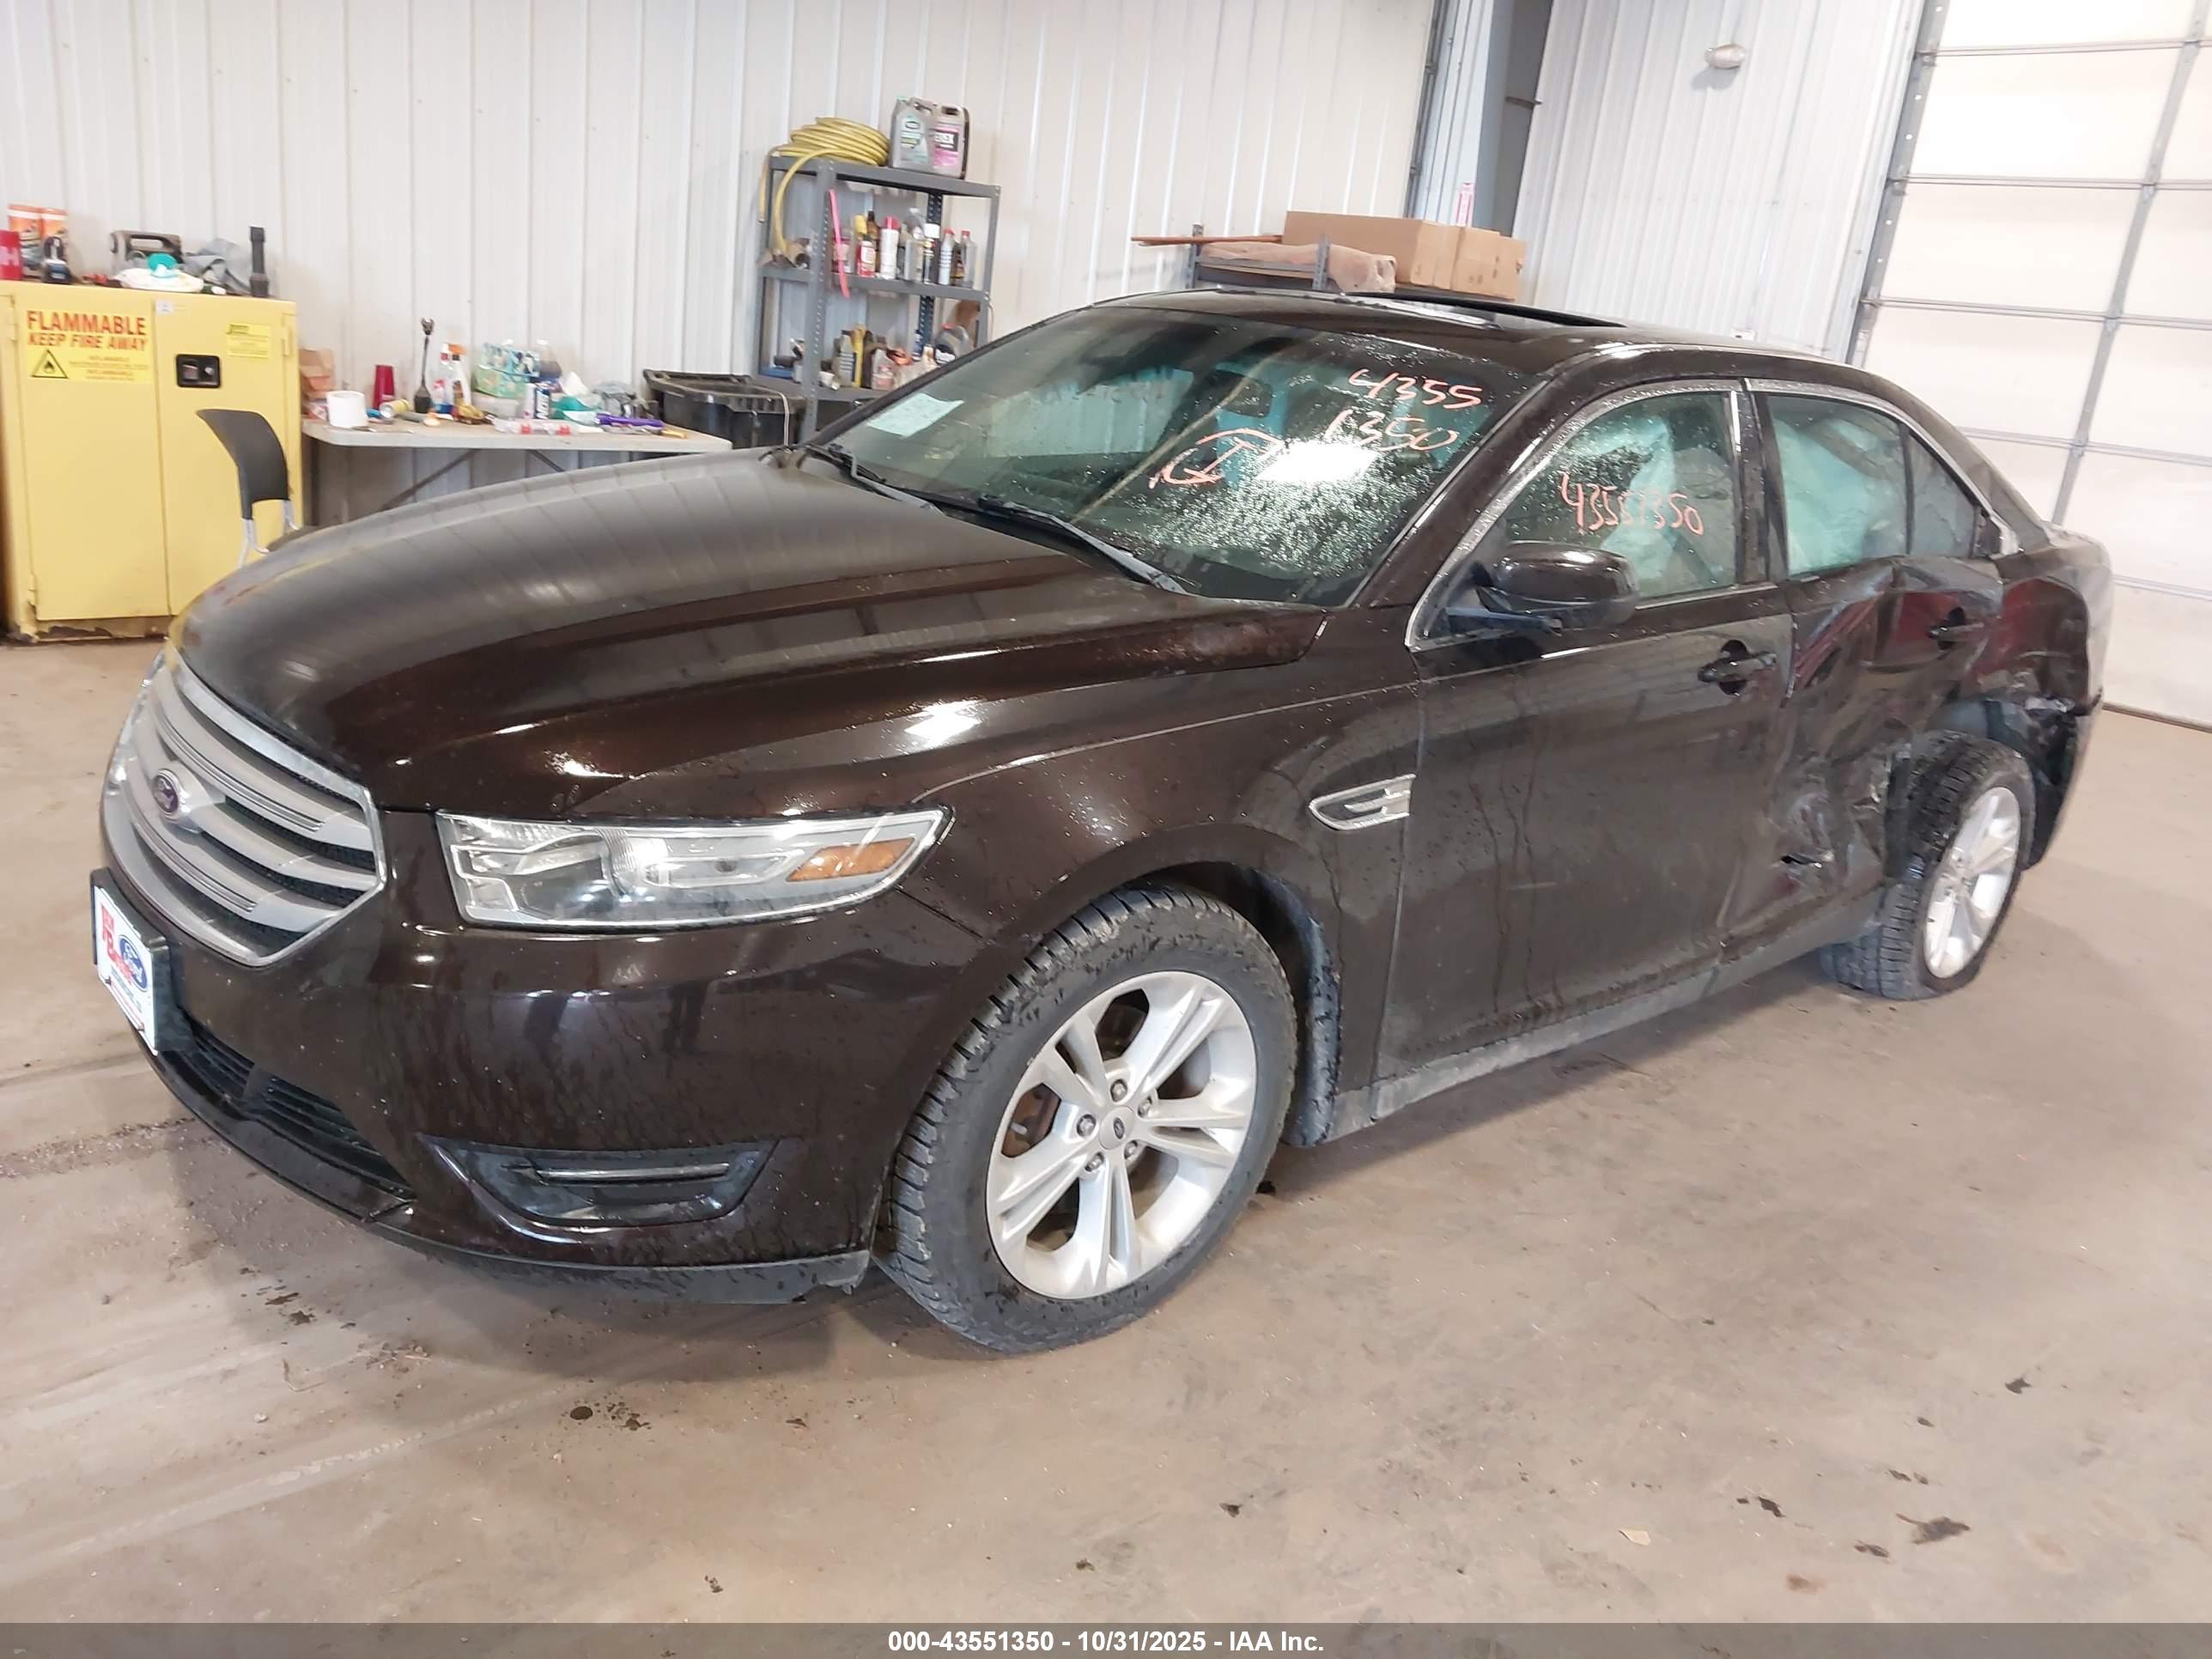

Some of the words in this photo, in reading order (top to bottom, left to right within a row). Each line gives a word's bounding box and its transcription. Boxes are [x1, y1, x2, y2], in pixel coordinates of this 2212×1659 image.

[27, 310, 146, 336] FLAMMABLE
[28, 332, 66, 347] KEEP
[71, 334, 104, 349] FIRE
[107, 336, 148, 351] AWAY
[1347, 368, 1483, 410] 4355
